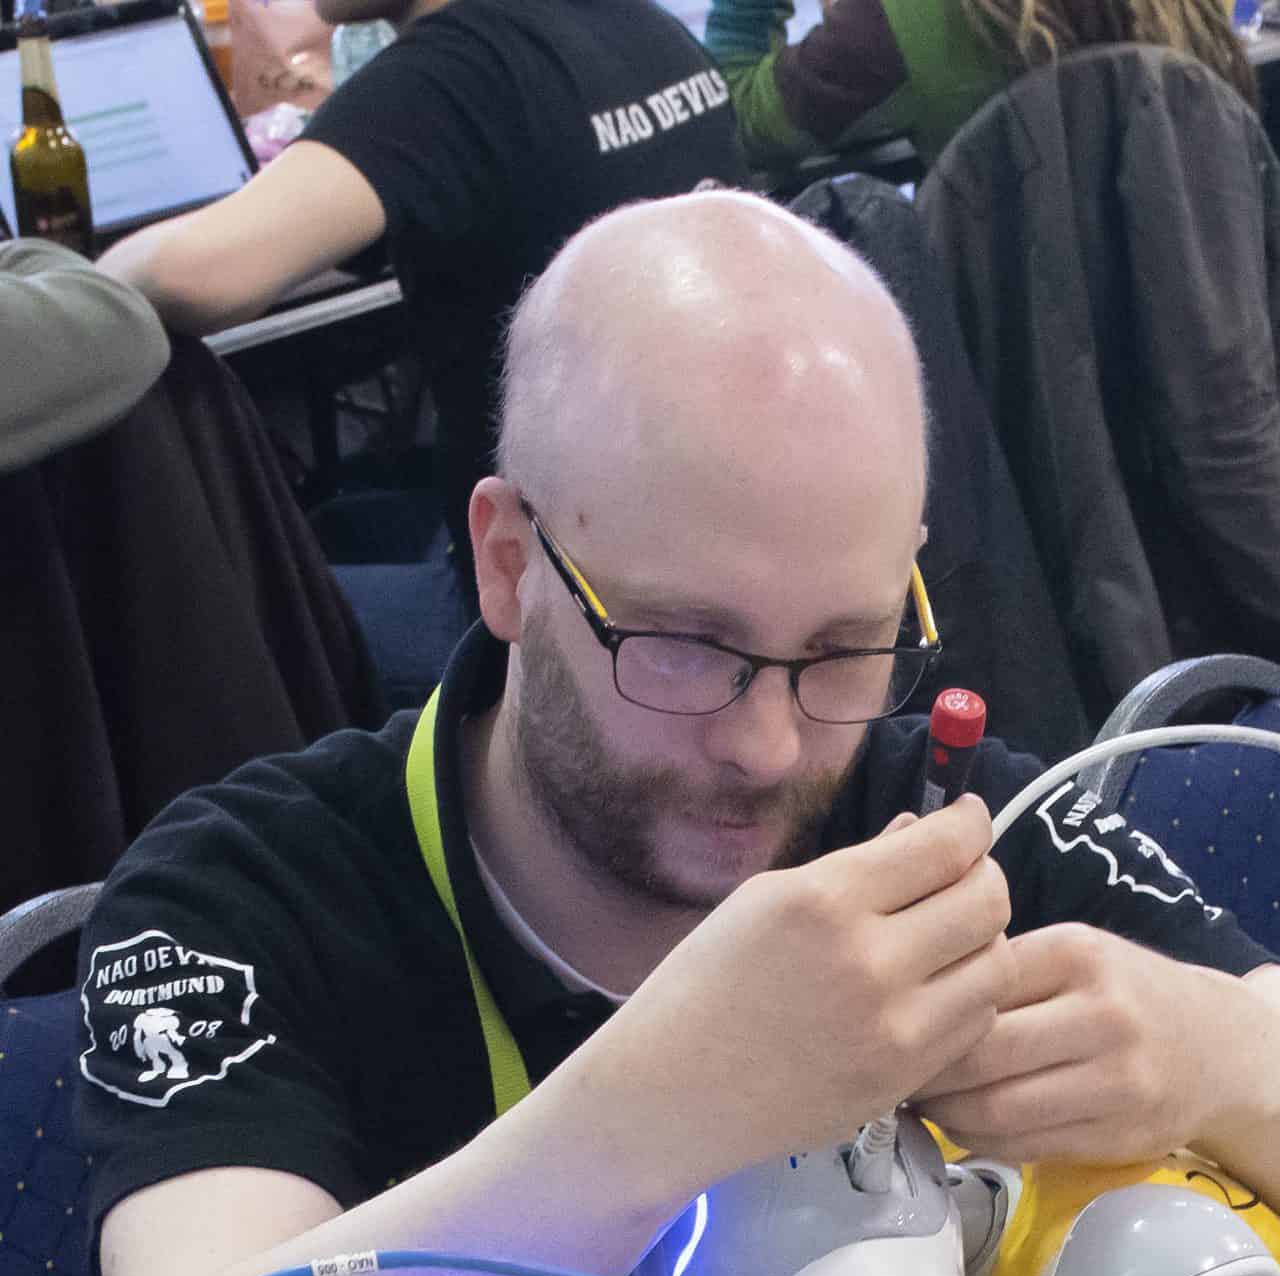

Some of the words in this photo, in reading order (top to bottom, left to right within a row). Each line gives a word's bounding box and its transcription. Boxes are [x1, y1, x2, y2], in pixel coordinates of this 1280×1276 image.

[591, 104, 653, 152] NAO
[96, 956, 137, 990] NAO
[104, 975, 225, 1006] DORTMUND
[109, 1023, 128, 1051] 20
[188, 1020, 224, 1040] 08
[347, 1257, 374, 1272] NAO
